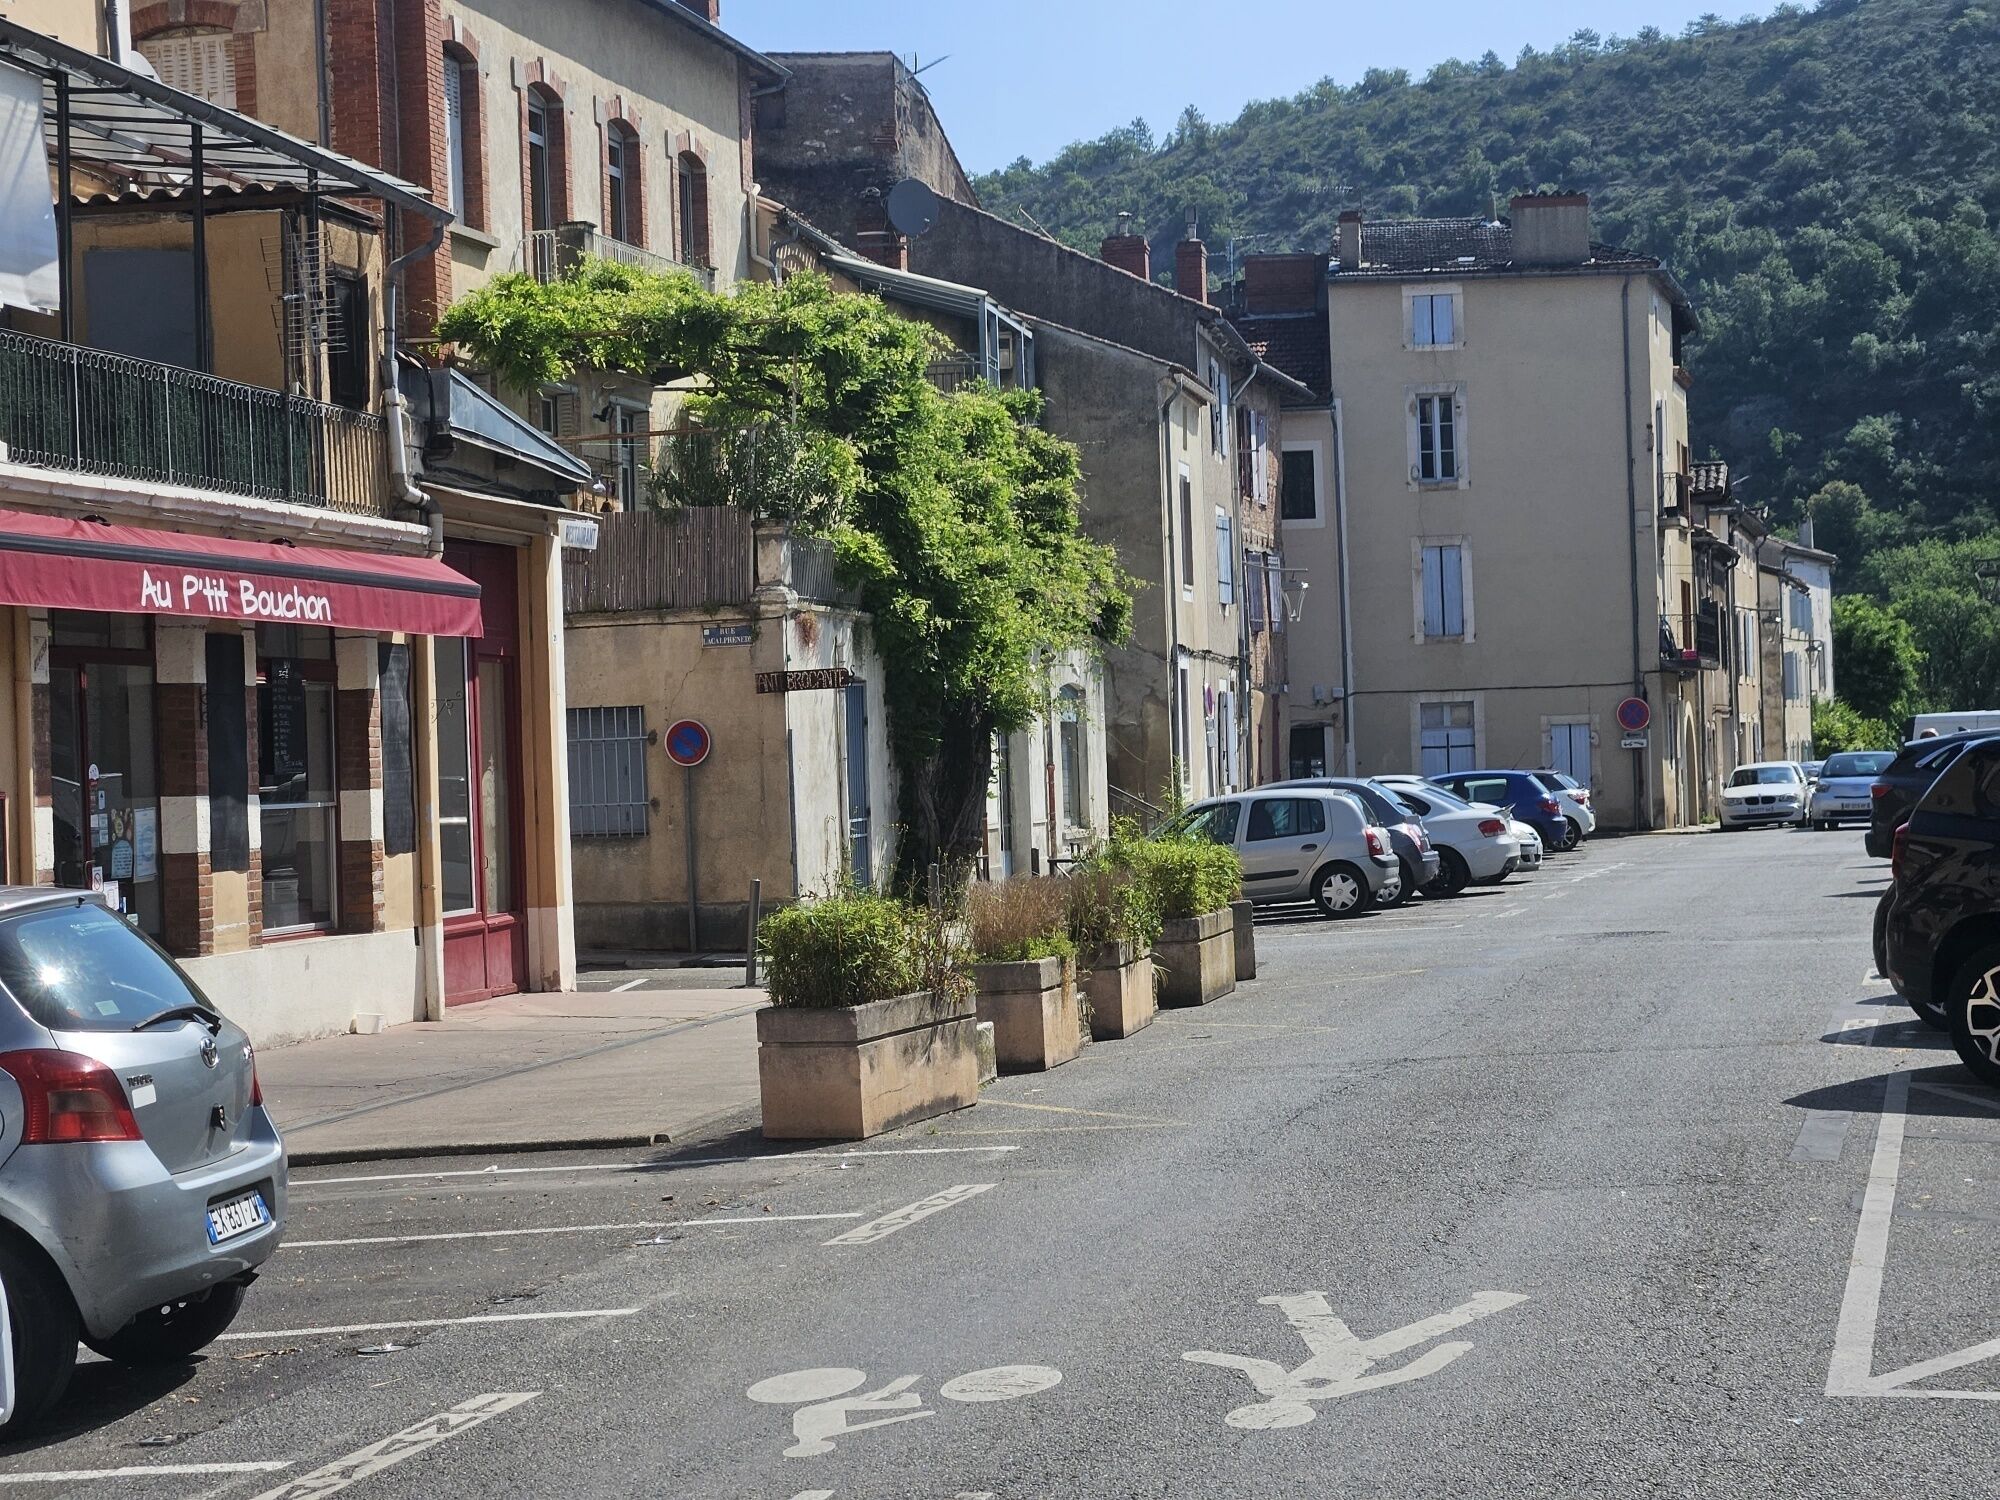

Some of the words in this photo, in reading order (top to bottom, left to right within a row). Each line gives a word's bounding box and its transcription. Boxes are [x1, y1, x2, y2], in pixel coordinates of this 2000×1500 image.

[141, 569, 173, 609] Au
[182, 574, 229, 613] P'tit
[238, 579, 332, 621] Bouchon
[719, 627, 736, 635] RUE
[786, 668, 848, 690] BROCANTE
